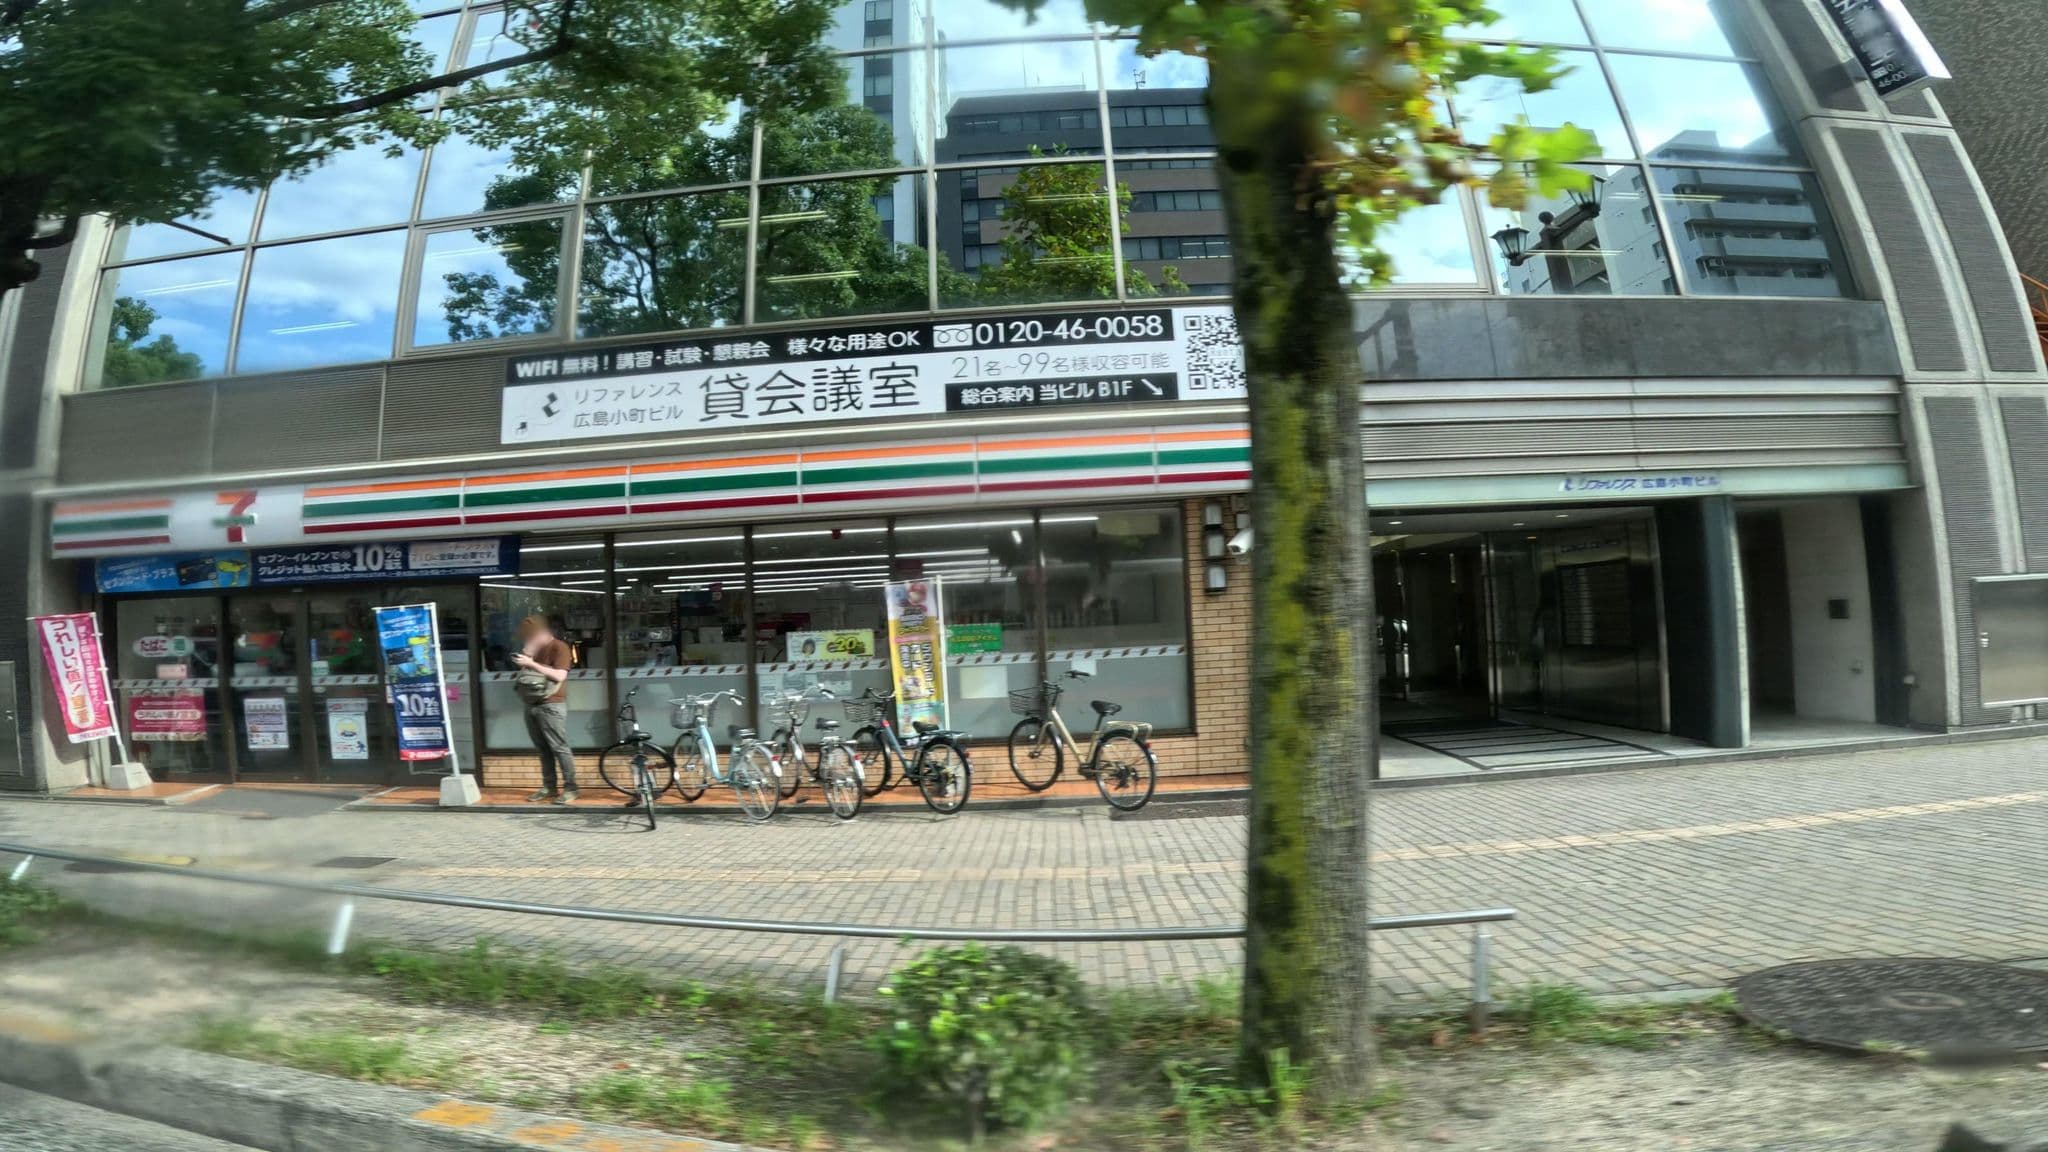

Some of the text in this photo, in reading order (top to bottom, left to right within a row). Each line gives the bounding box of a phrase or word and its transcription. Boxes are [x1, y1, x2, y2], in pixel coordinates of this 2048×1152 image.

[516, 359, 558, 378] WIFI
[787, 330, 921, 356] 様々な用途OK
[975, 314, 1164, 345] 0120-46-0058
[575, 381, 683, 405] リファレンス
[699, 361, 921, 422] 貸会議室
[960, 380, 1134, 405] 総合案内 当ビル B1F
[573, 404, 685, 428] 広島小町ビル
